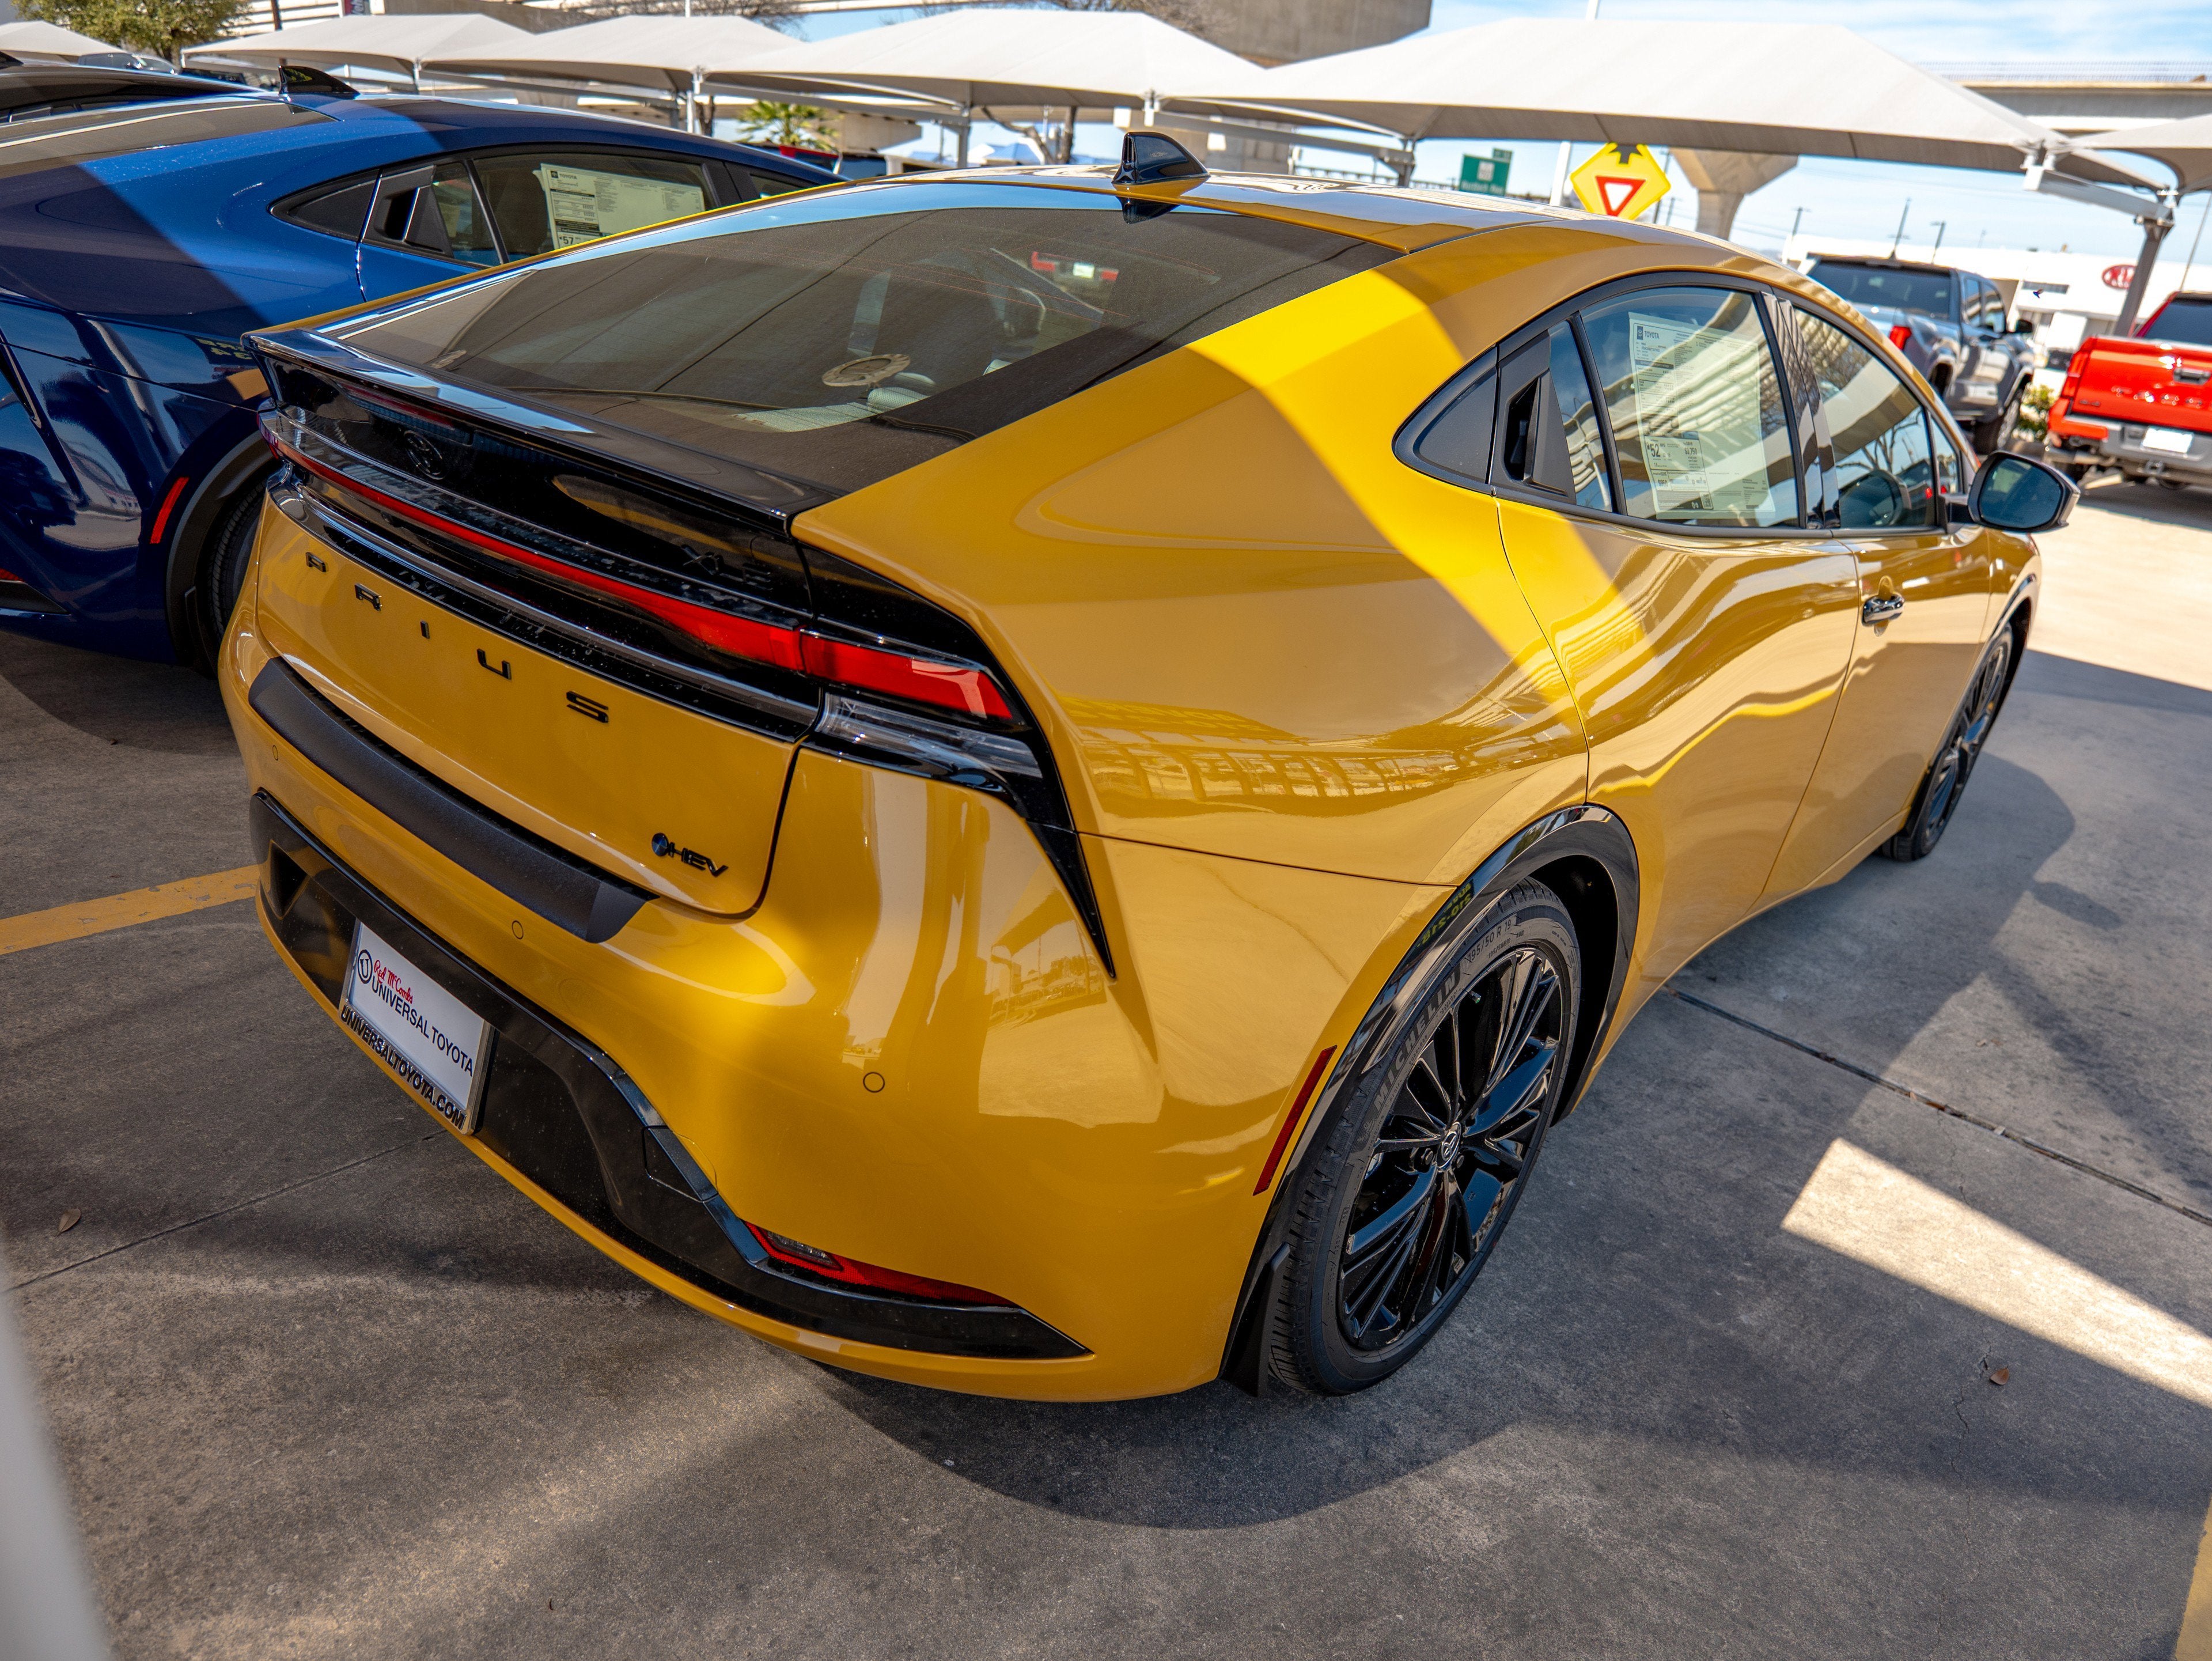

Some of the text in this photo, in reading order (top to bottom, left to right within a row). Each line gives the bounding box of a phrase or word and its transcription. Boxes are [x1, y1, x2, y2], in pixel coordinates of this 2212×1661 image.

[563, 236, 574, 245] 57
[1644, 331, 1660, 339] TOYOTA
[1650, 443, 1661, 457] 52
[681, 544, 773, 591] XLE
[305, 551, 609, 724] PRIUS
[668, 841, 729, 878] HEV
[374, 959, 386, 985] Red
[387, 969, 414, 1004] McCombs
[372, 975, 473, 1077] UNIVERSAL TOYOTA
[1372, 970, 1456, 1111] MICHELIN
[340, 1005, 467, 1130] UNIVERSALTOYOTA.COM
